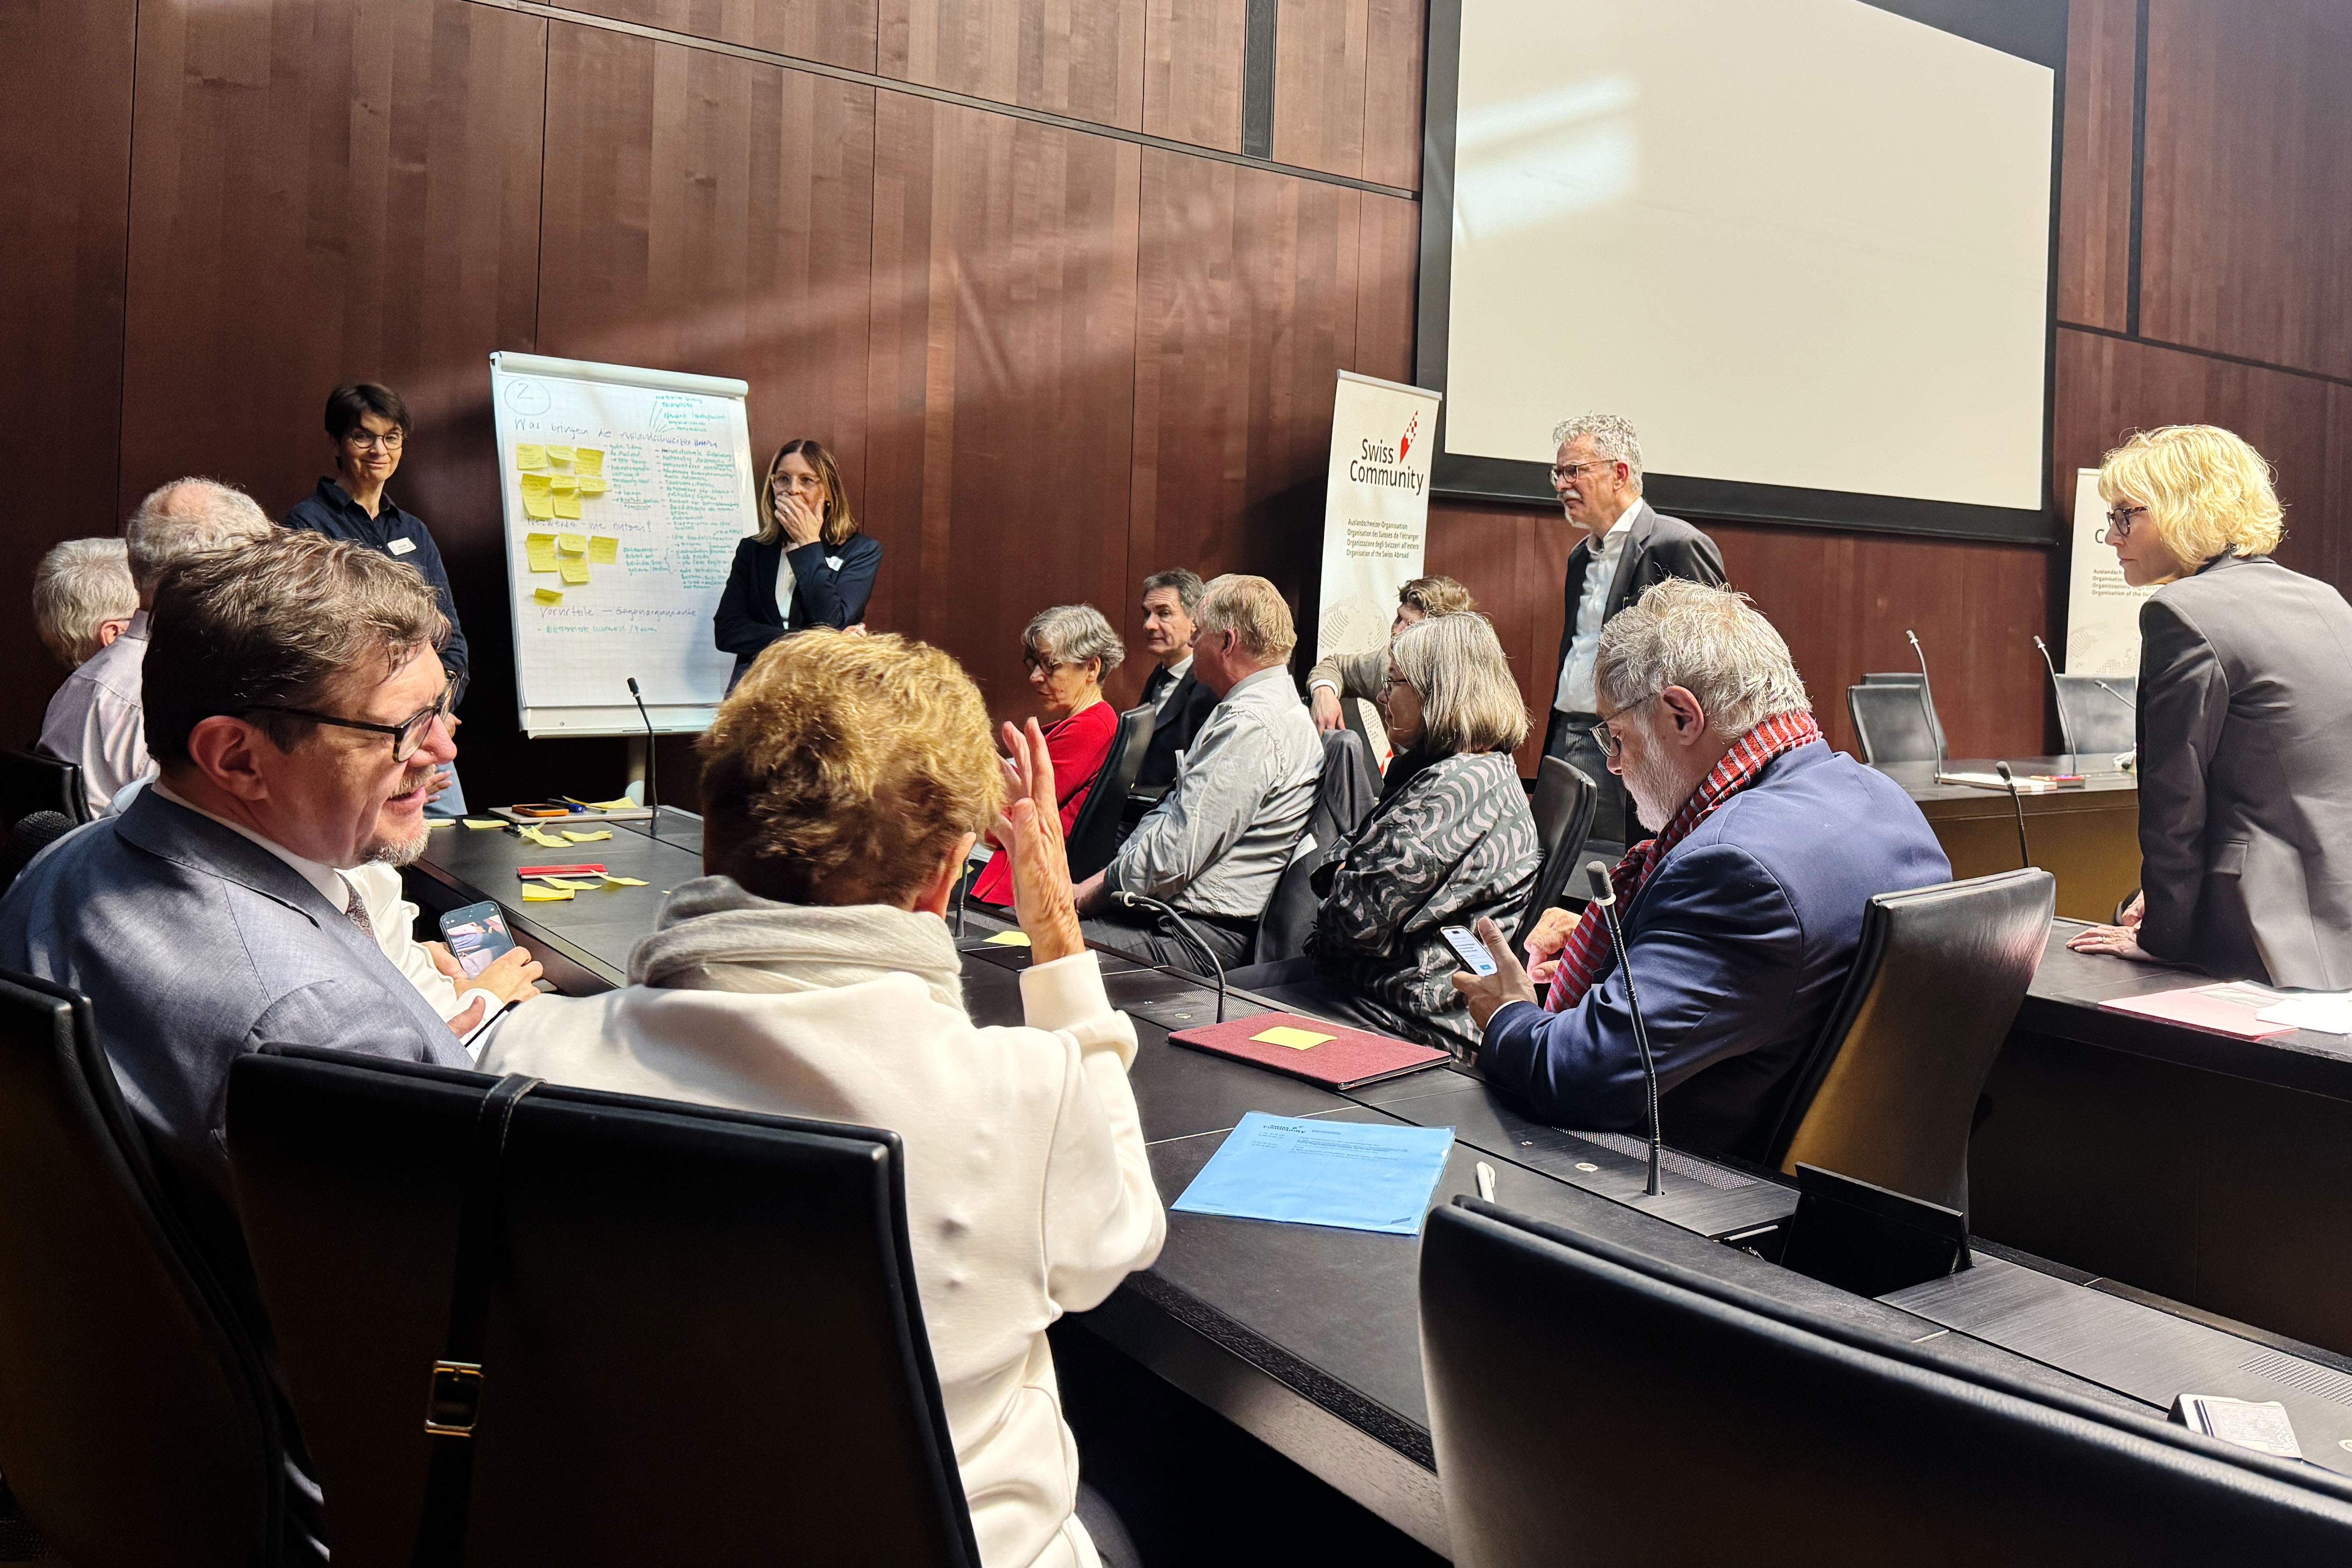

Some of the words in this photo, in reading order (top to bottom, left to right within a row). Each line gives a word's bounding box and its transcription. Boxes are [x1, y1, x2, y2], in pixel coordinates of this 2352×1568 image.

[517, 383, 534, 399] 2
[515, 418, 540, 431] Was
[551, 422, 588, 440] bringen
[598, 427, 611, 437] die
[1362, 438, 1394, 464] Swiss
[1350, 460, 1424, 496] Community
[1348, 518, 1407, 530] Auslandschweizer-Organisation
[1348, 529, 1371, 538] Organisation
[1347, 539, 1375, 548] Organizzazione
[1375, 540, 1384, 549] degli
[1347, 549, 1370, 558] Organisation
